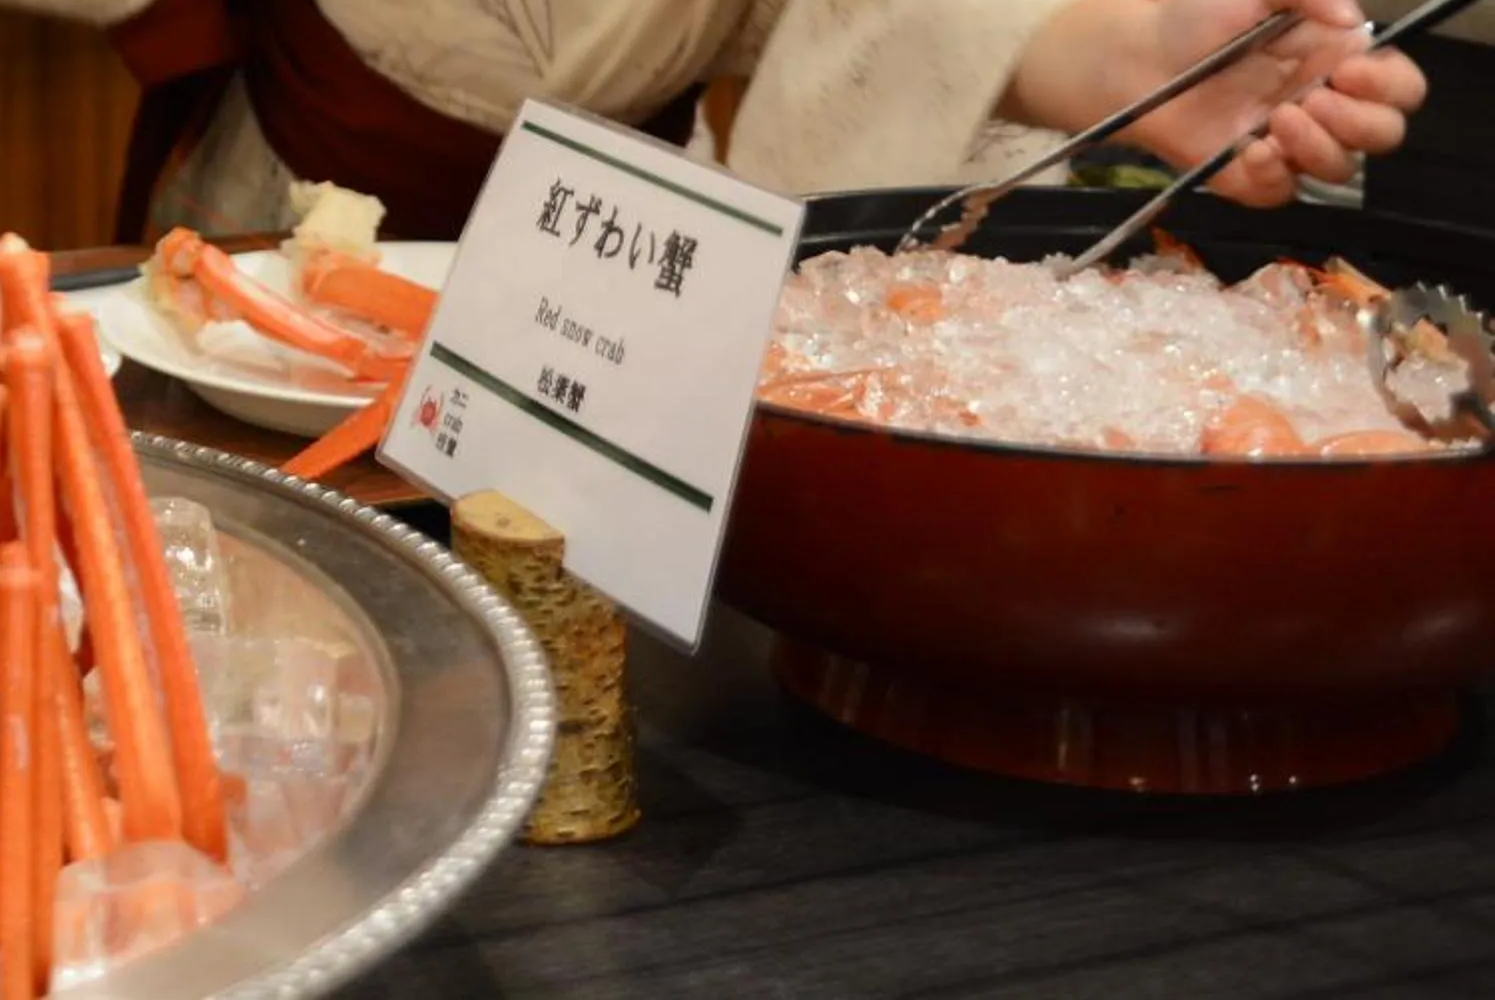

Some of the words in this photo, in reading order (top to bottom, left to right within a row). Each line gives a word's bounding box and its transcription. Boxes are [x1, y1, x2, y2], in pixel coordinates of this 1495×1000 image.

[535, 177, 699, 298] 紅ずわい蟹
[534, 295, 563, 331] Red
[559, 317, 594, 347] snow
[594, 335, 625, 365] crab
